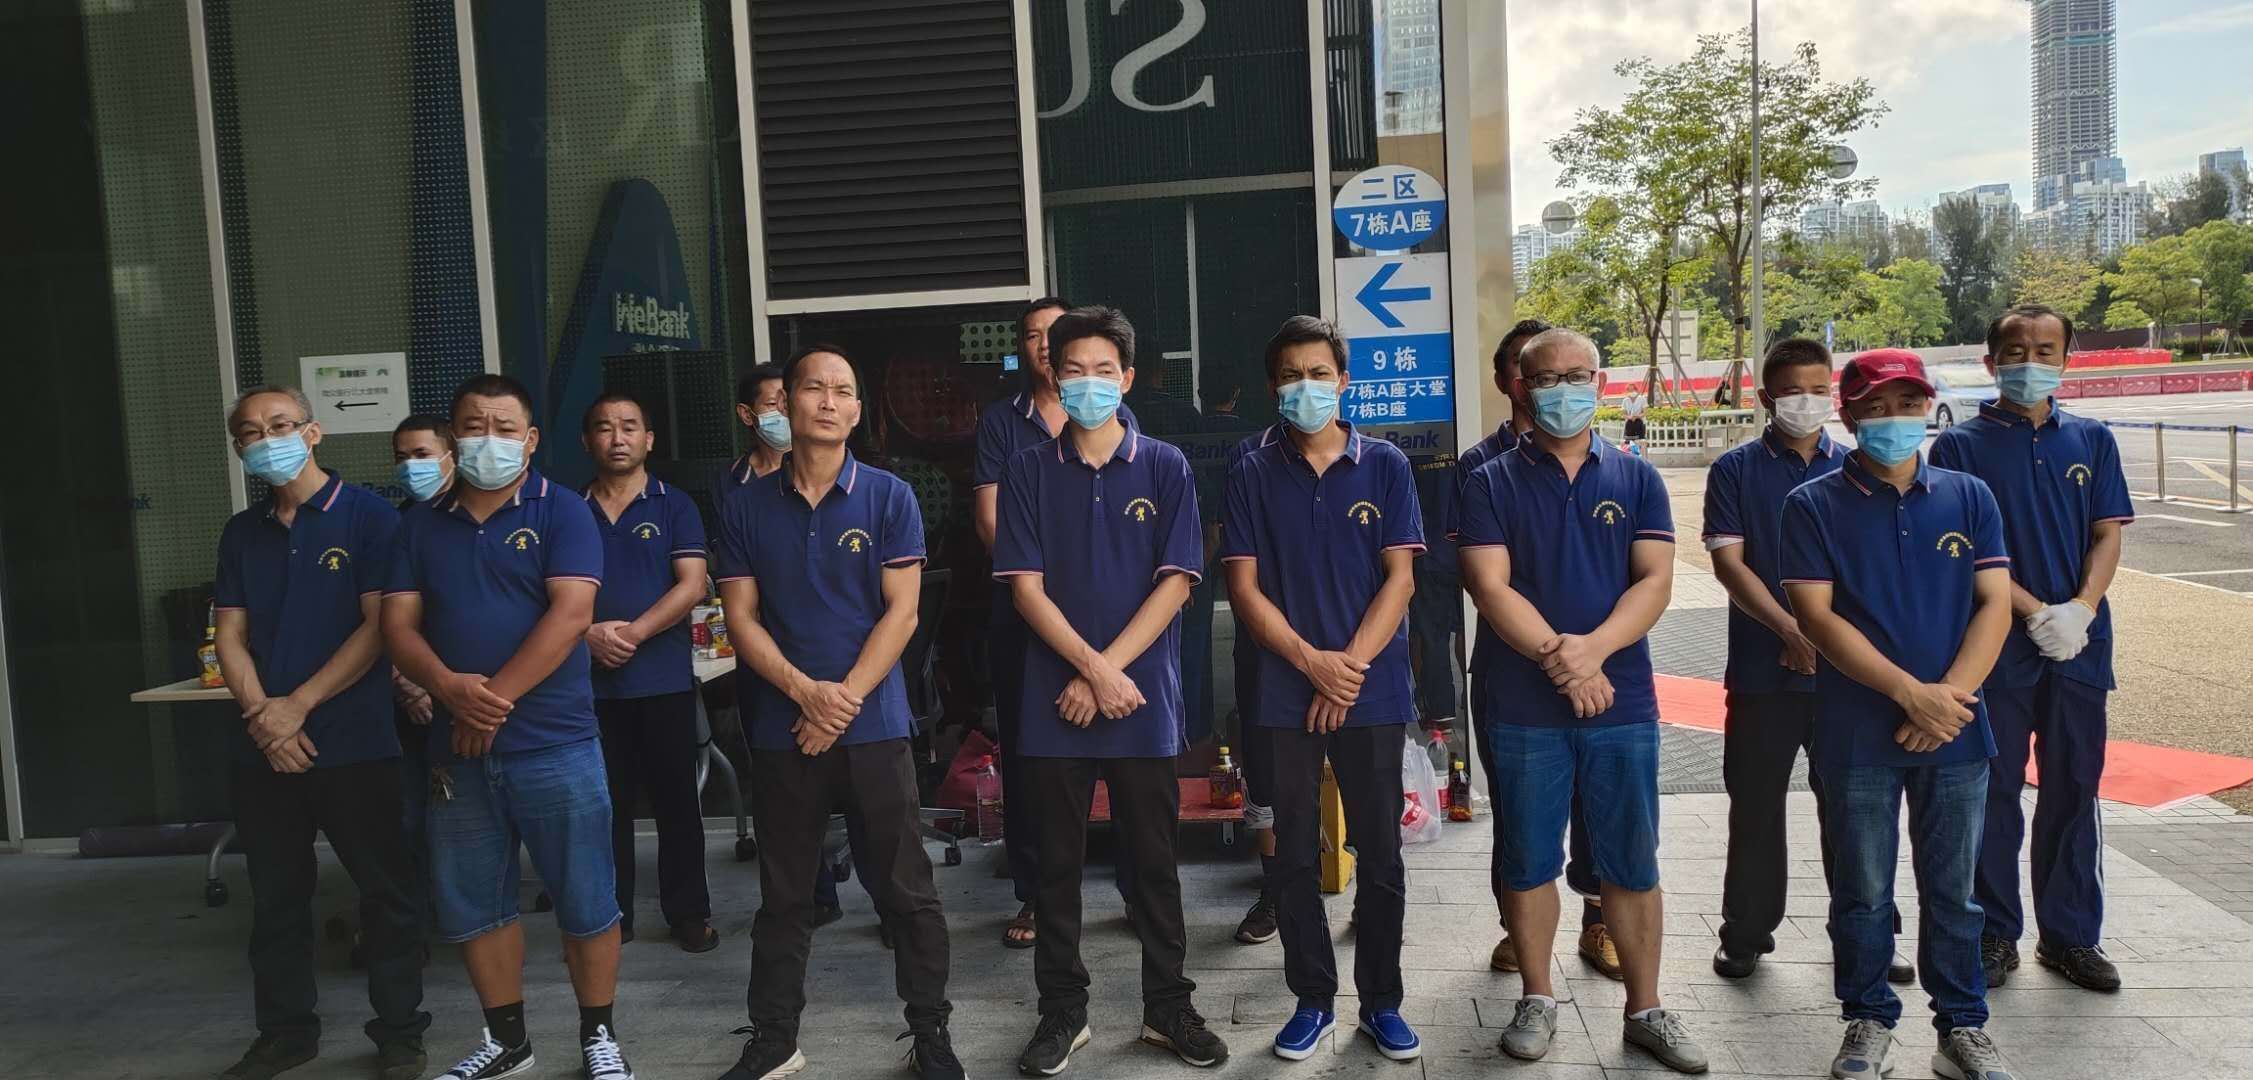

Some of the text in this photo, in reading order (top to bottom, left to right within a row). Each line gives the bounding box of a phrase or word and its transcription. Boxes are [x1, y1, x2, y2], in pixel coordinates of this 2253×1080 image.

[1361, 173, 1419, 200] 二区
[1349, 209, 1433, 237] 7栋A座
[1347, 379, 1447, 401] 7栋A座大堂
[1347, 401, 1408, 420] 7栋B座
[1373, 429, 1441, 449] Bank
